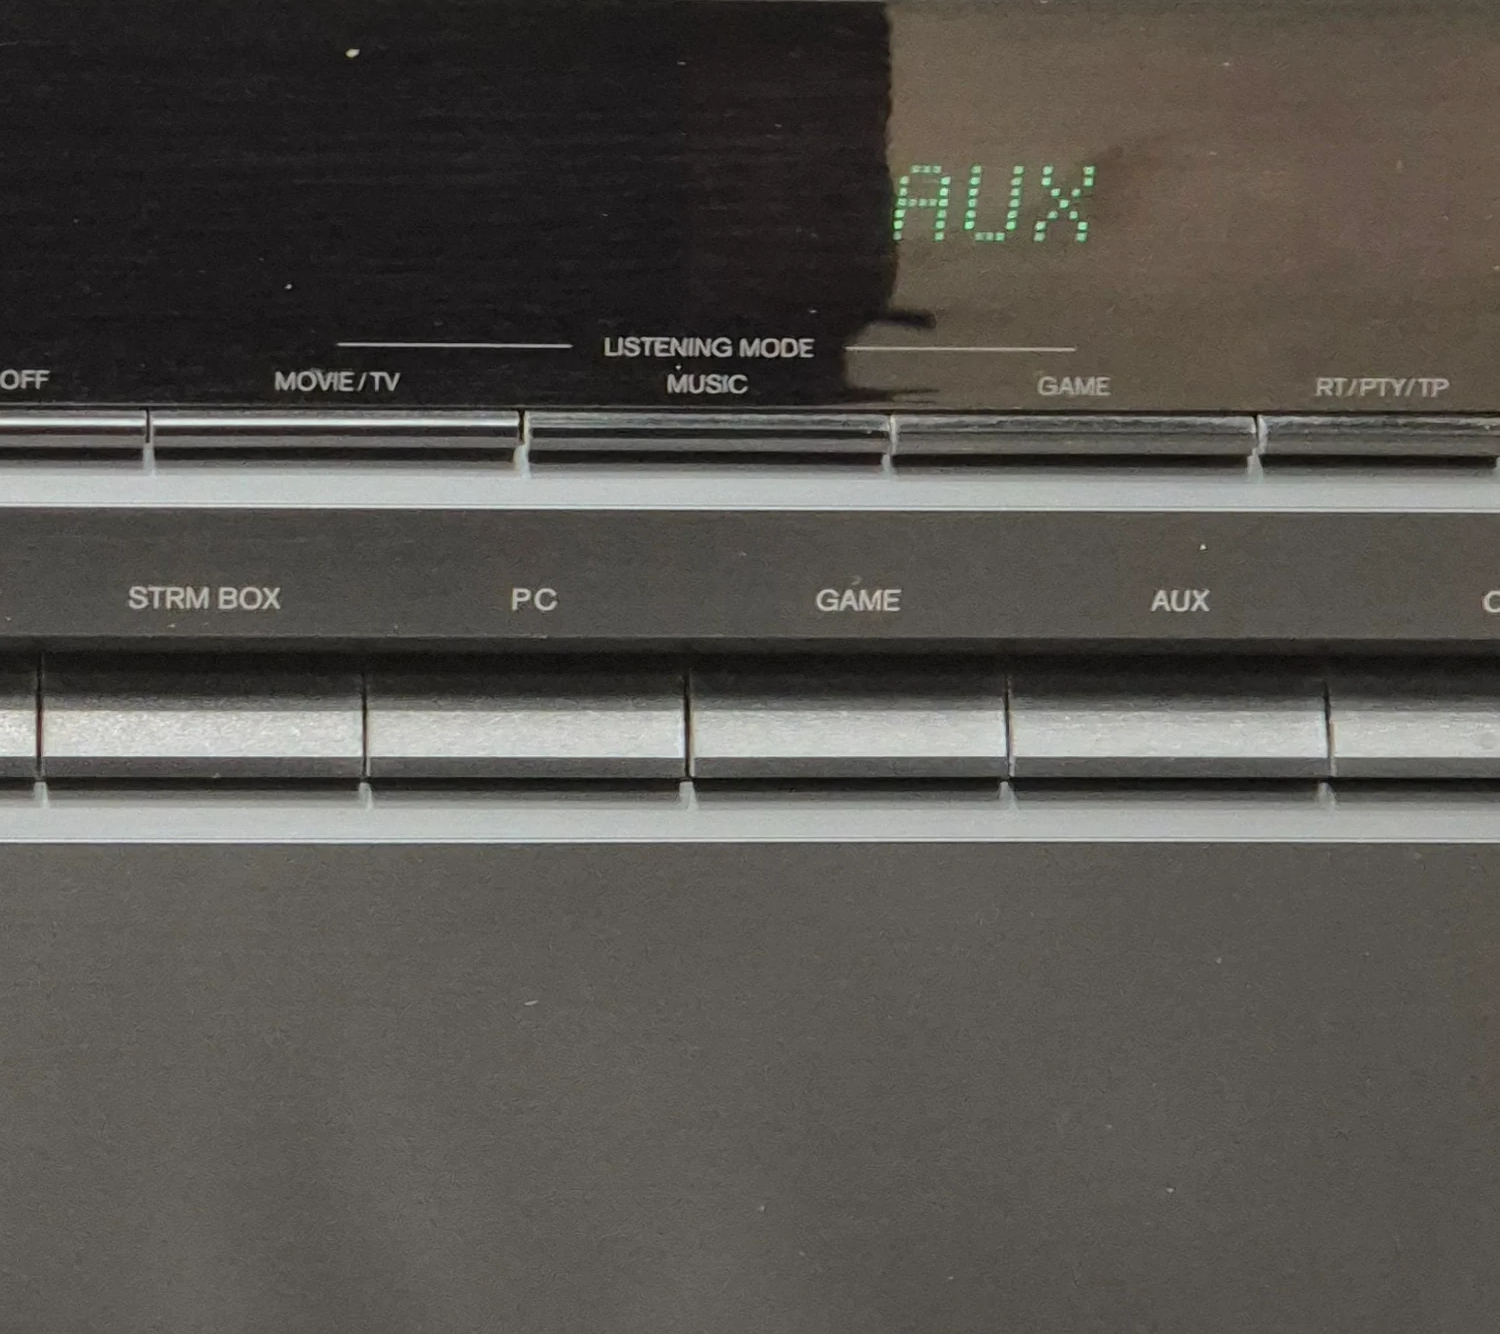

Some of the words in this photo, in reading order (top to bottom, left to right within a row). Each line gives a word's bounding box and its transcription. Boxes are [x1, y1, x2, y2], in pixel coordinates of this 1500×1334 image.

[893, 165, 1096, 242] AUX
[604, 336, 733, 358] LISTENING
[739, 337, 815, 359] MODE
[666, 373, 748, 395] MUSIC
[1037, 375, 1110, 397] GAME
[1315, 376, 1450, 398] RT/PTY/TP
[128, 585, 210, 610] STRM
[218, 586, 281, 611] BOX
[511, 587, 558, 612] PC
[815, 588, 901, 612] GAME
[1150, 589, 1210, 613] AUX
